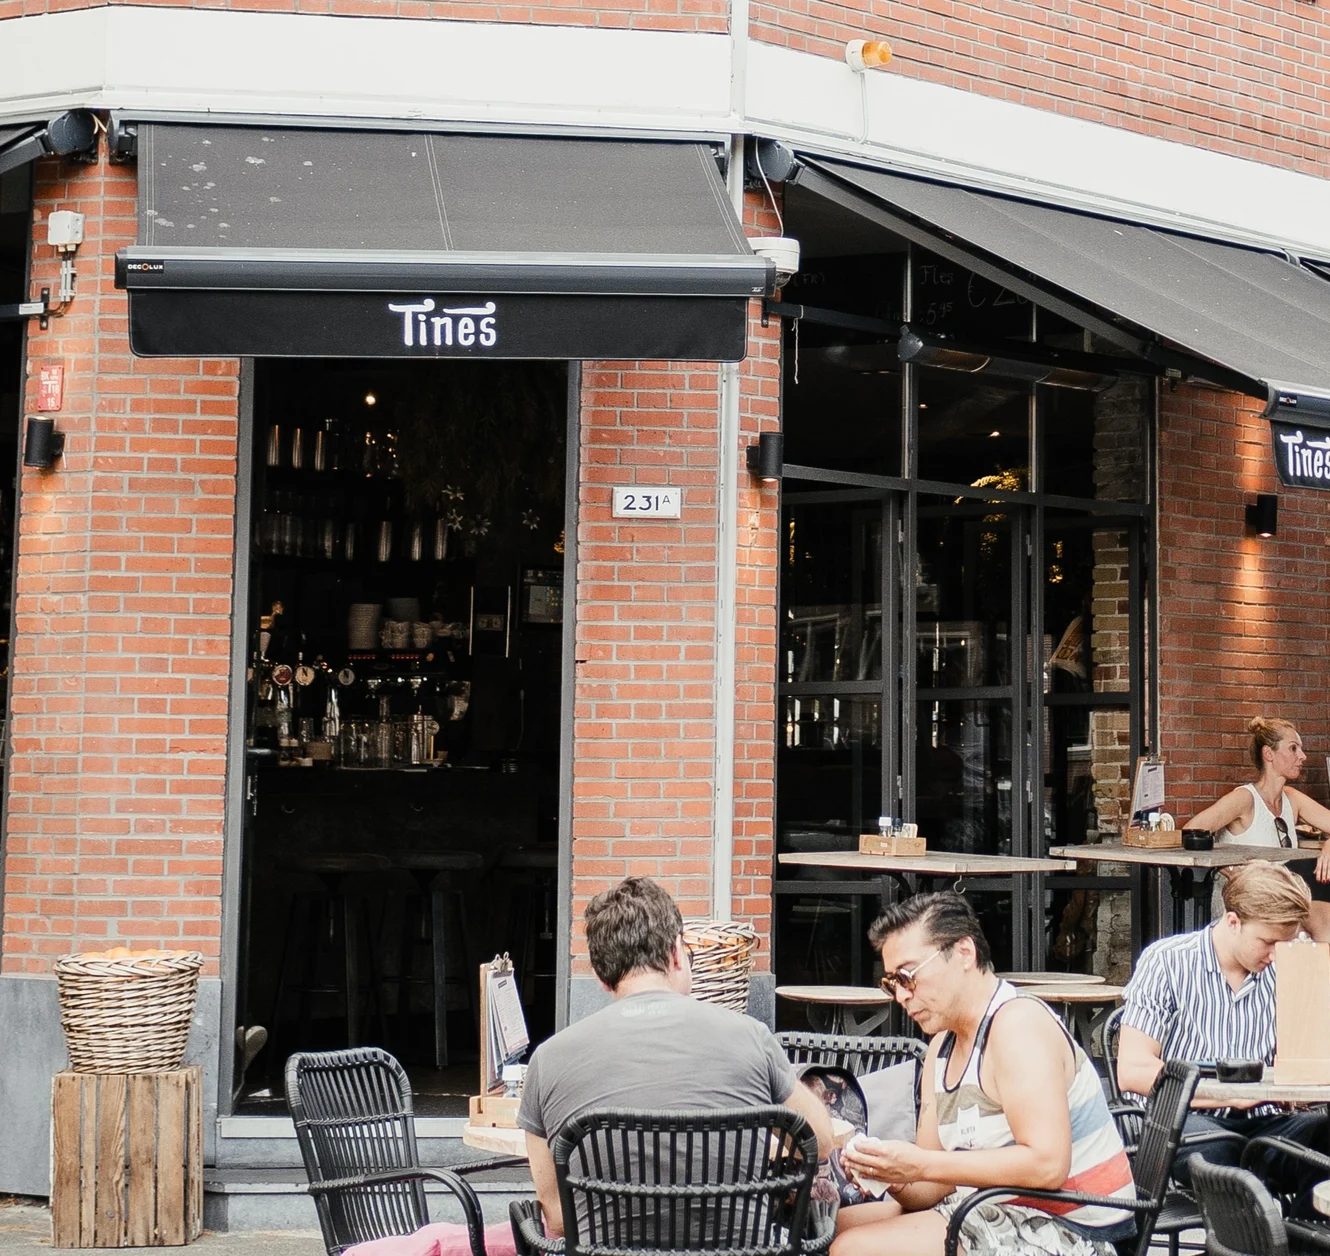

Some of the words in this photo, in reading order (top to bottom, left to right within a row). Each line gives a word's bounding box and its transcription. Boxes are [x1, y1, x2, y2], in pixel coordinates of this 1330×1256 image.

[127, 262, 164, 271] DECOLUX
[388, 298, 497, 347] Tines
[623, 494, 671, 511] 231A
